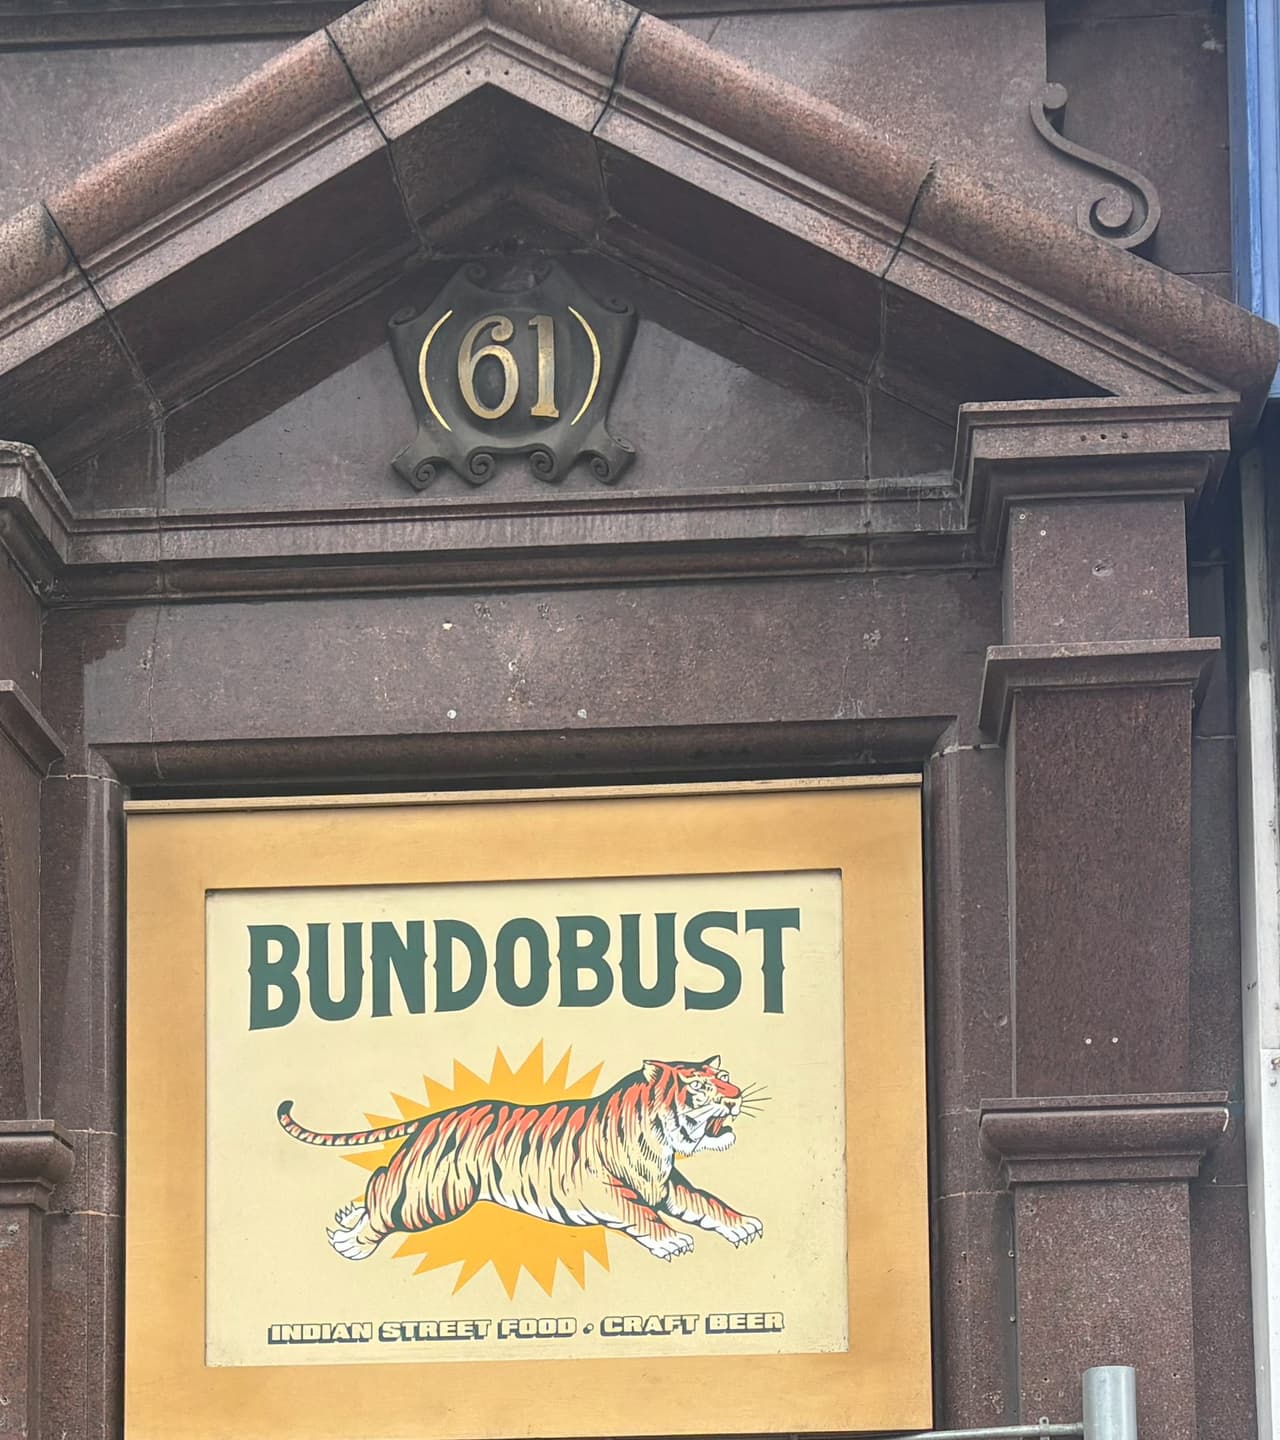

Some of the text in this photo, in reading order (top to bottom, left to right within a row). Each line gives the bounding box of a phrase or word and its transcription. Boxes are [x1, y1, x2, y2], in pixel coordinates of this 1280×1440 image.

[458, 314, 560, 420] 61
[246, 907, 801, 1031] BUNDOBUST
[267, 1311, 786, 1346] INDIAN STREET FOOD CRAFT BEER
